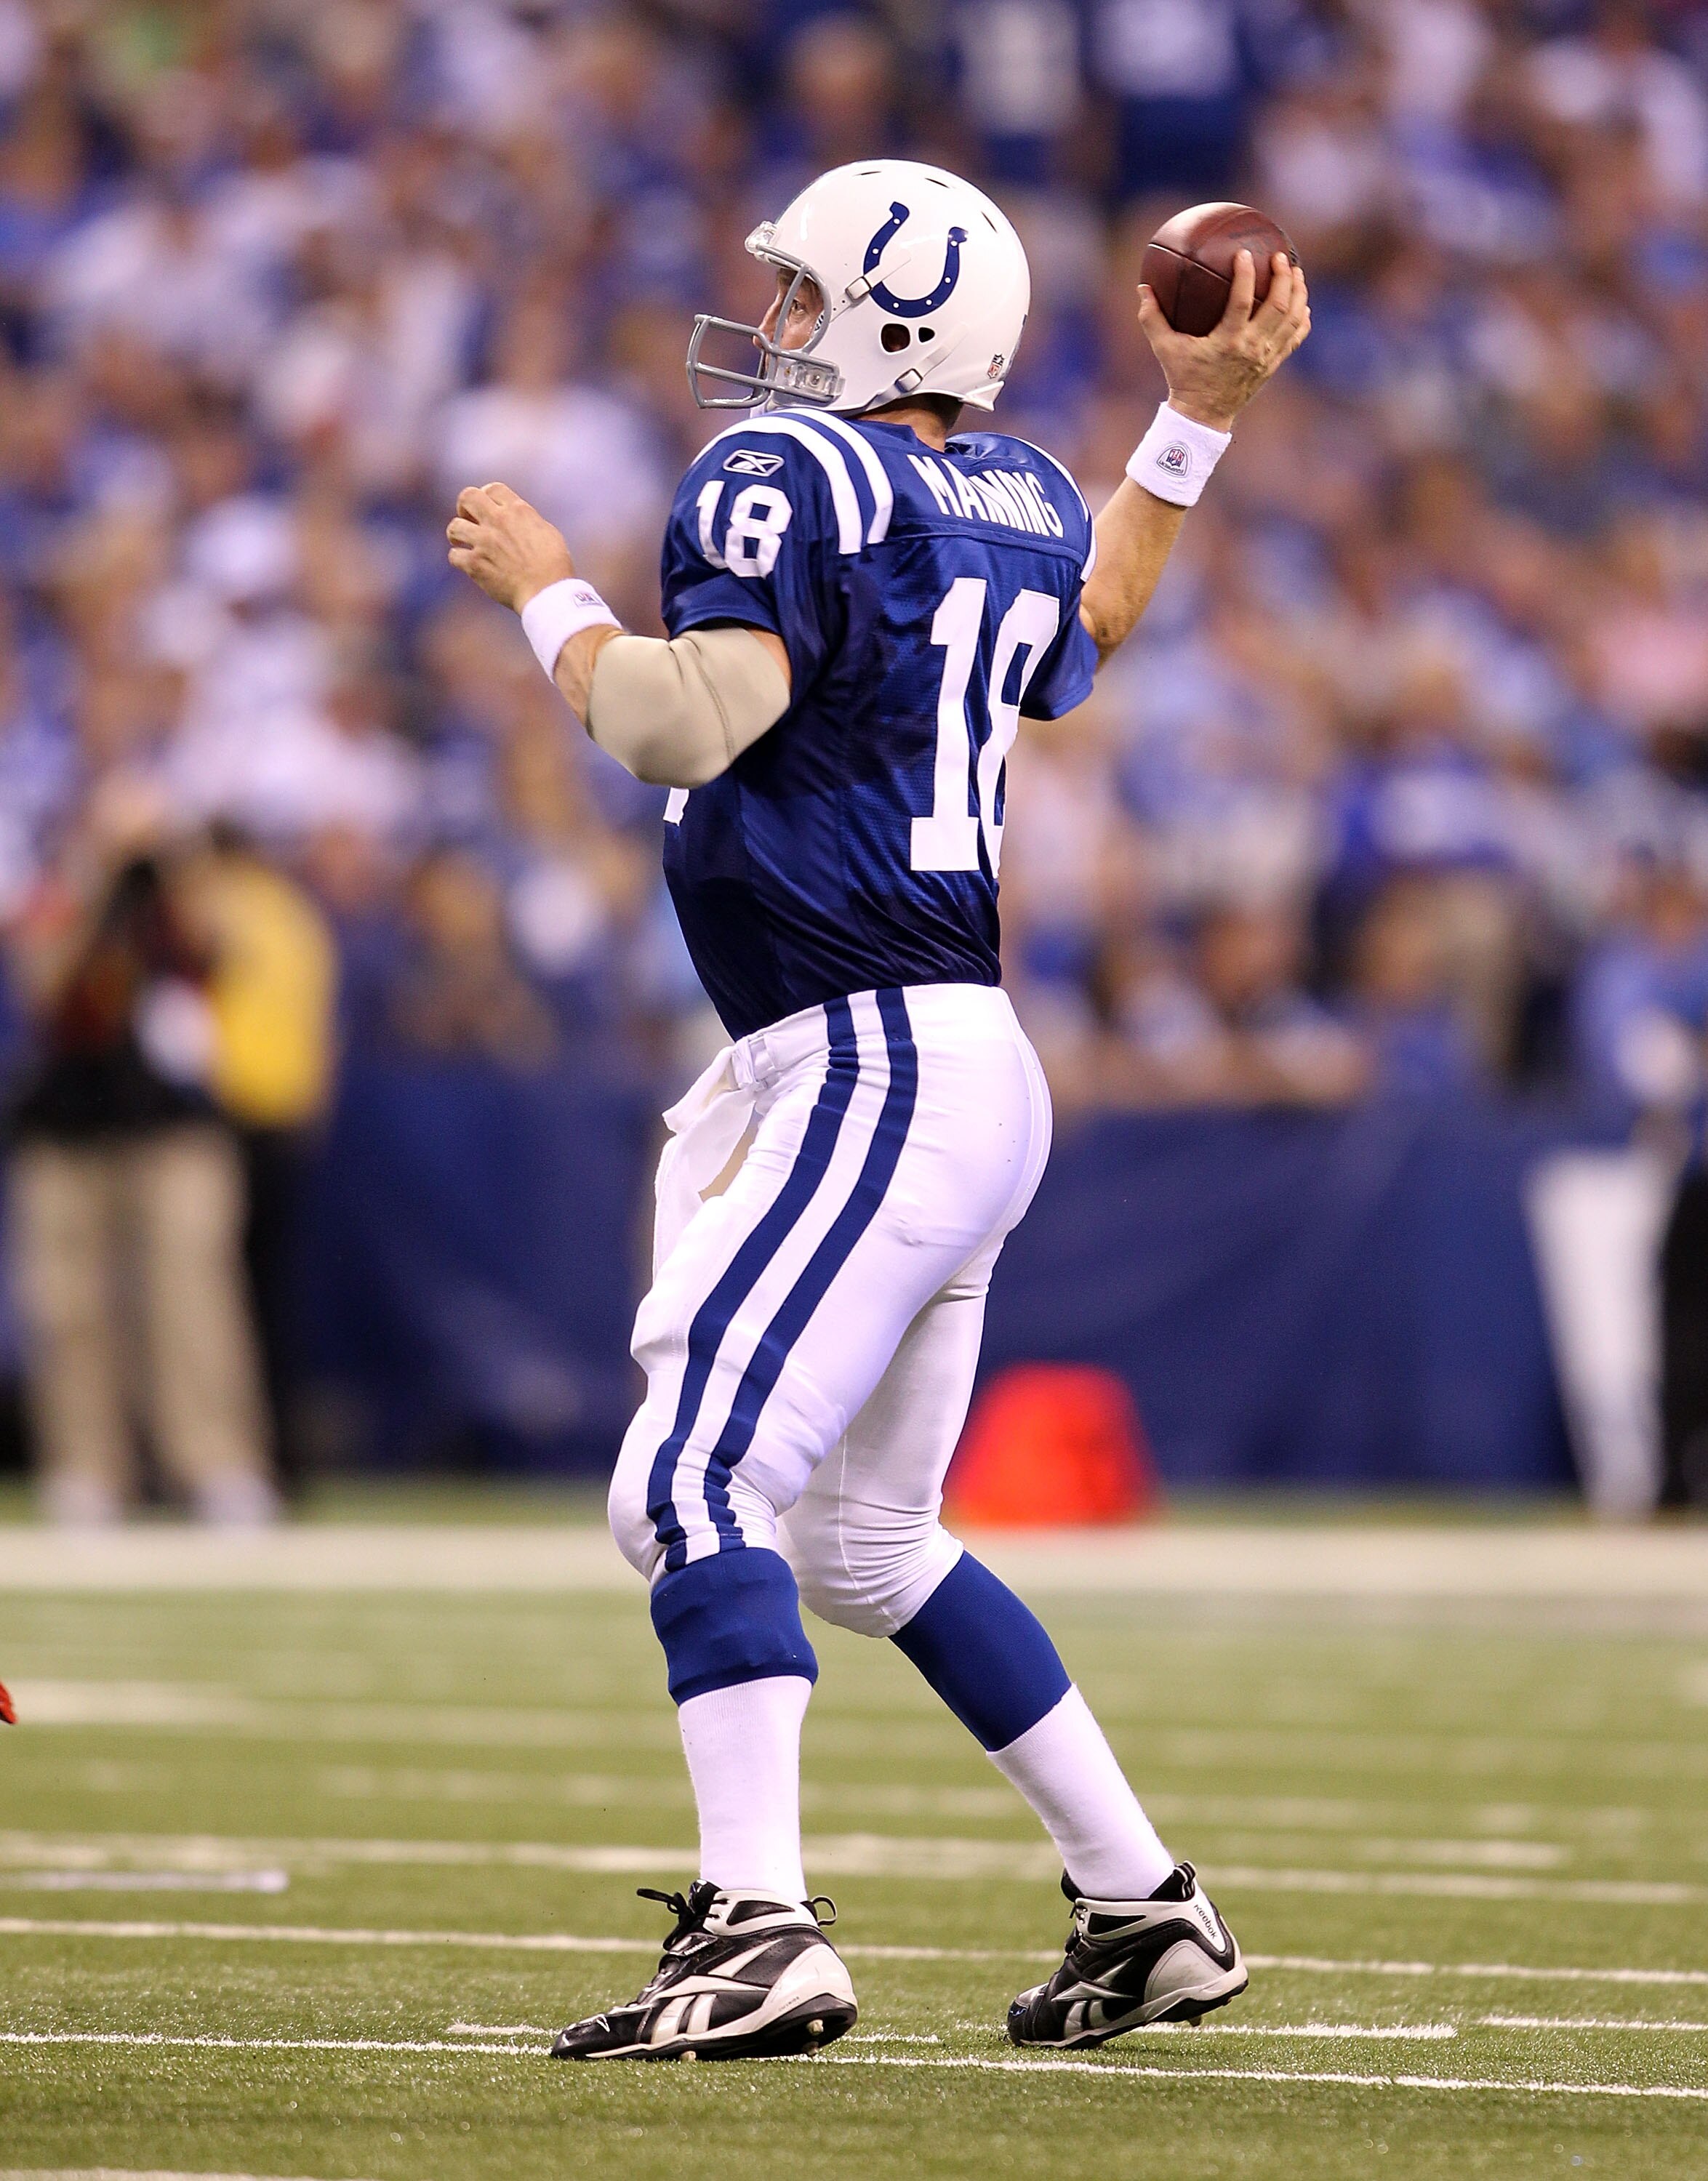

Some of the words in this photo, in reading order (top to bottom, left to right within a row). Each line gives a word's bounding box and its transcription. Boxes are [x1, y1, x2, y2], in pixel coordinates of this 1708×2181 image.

[696, 480, 794, 580] 18
[907, 454, 1064, 538] MANNING
[910, 578, 1060, 879] 18
[1193, 1904, 1218, 1939] Reebok
